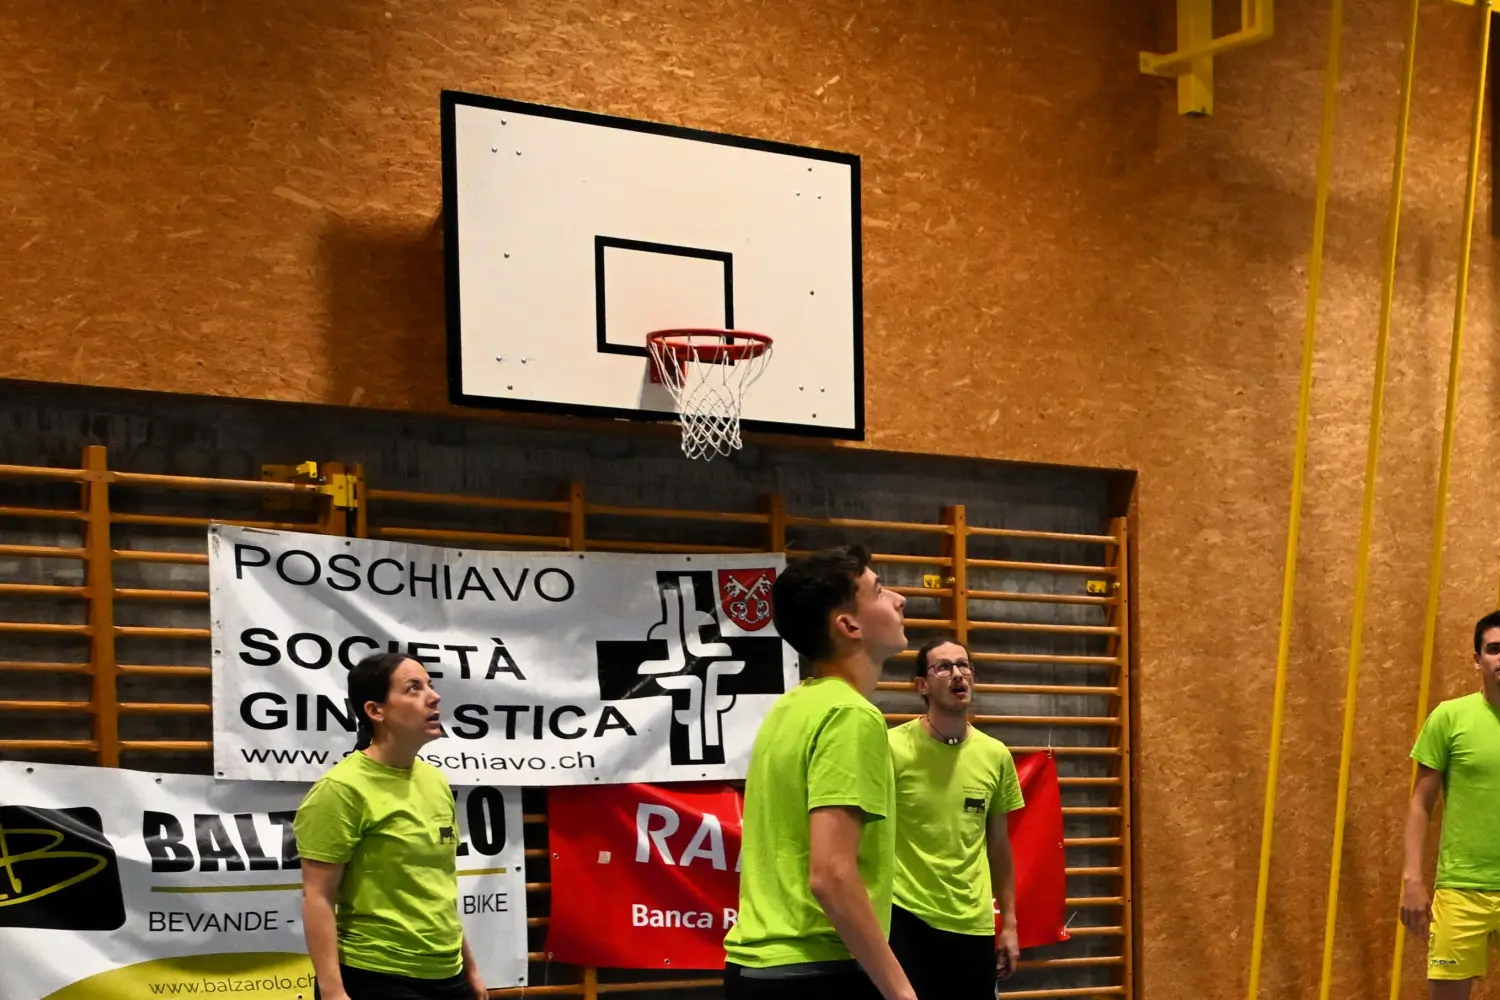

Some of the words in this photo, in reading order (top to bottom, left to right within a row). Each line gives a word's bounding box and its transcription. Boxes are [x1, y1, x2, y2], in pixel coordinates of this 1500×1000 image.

[234, 543, 575, 602] POSCHIAVO
[149, 910, 279, 932] BEVANDE
[463, 893, 508, 915] BIKE
[631, 903, 714, 929] Banca
[149, 973, 317, 995] www.balzarolo.ch
